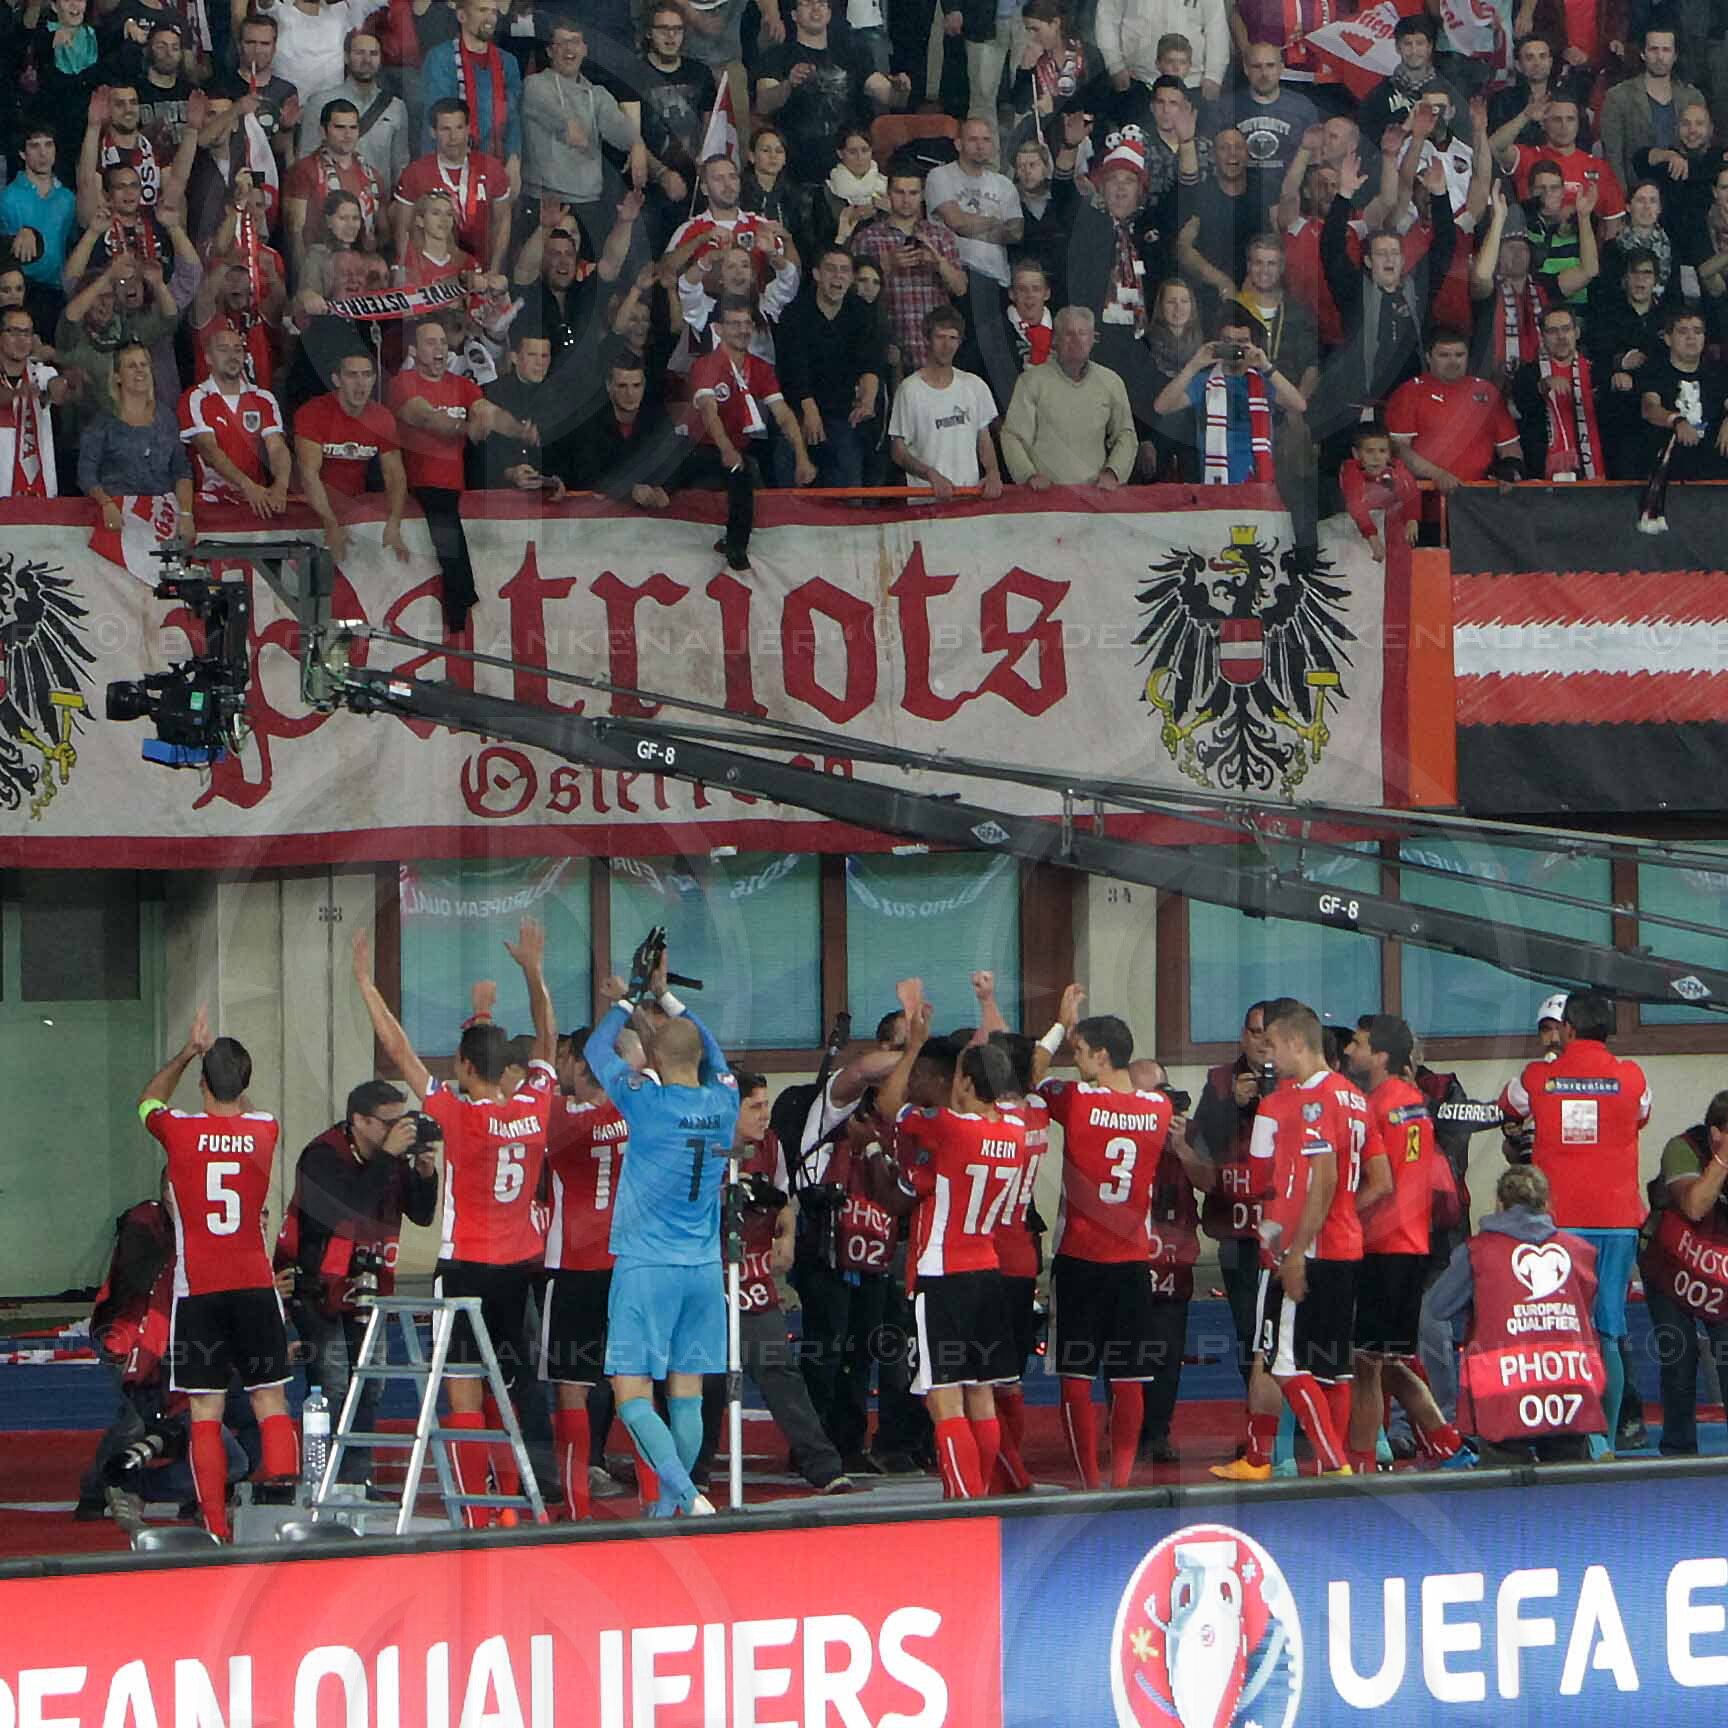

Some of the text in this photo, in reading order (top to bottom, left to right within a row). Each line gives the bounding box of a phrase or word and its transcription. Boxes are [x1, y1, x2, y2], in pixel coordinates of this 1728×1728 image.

[636, 739, 677, 766] GF-8
[1319, 894, 1360, 919] GF-8
[1089, 1107, 1158, 1132] DRAGOVIC
[197, 1132, 255, 1154] FUCHS
[980, 1137, 1017, 1160] KLEIN
[493, 1142, 526, 1203] 6
[1098, 1136, 1139, 1206] 3
[205, 1160, 242, 1236] 5
[962, 1163, 1022, 1237] 17
[1673, 1269, 1724, 1316] 002
[1499, 1349, 1593, 1387] PHOTO
[1519, 1393, 1584, 1429] 007
[1326, 1564, 1640, 1710] UEFA
[314, 1604, 951, 1728] QUALIFIERS
